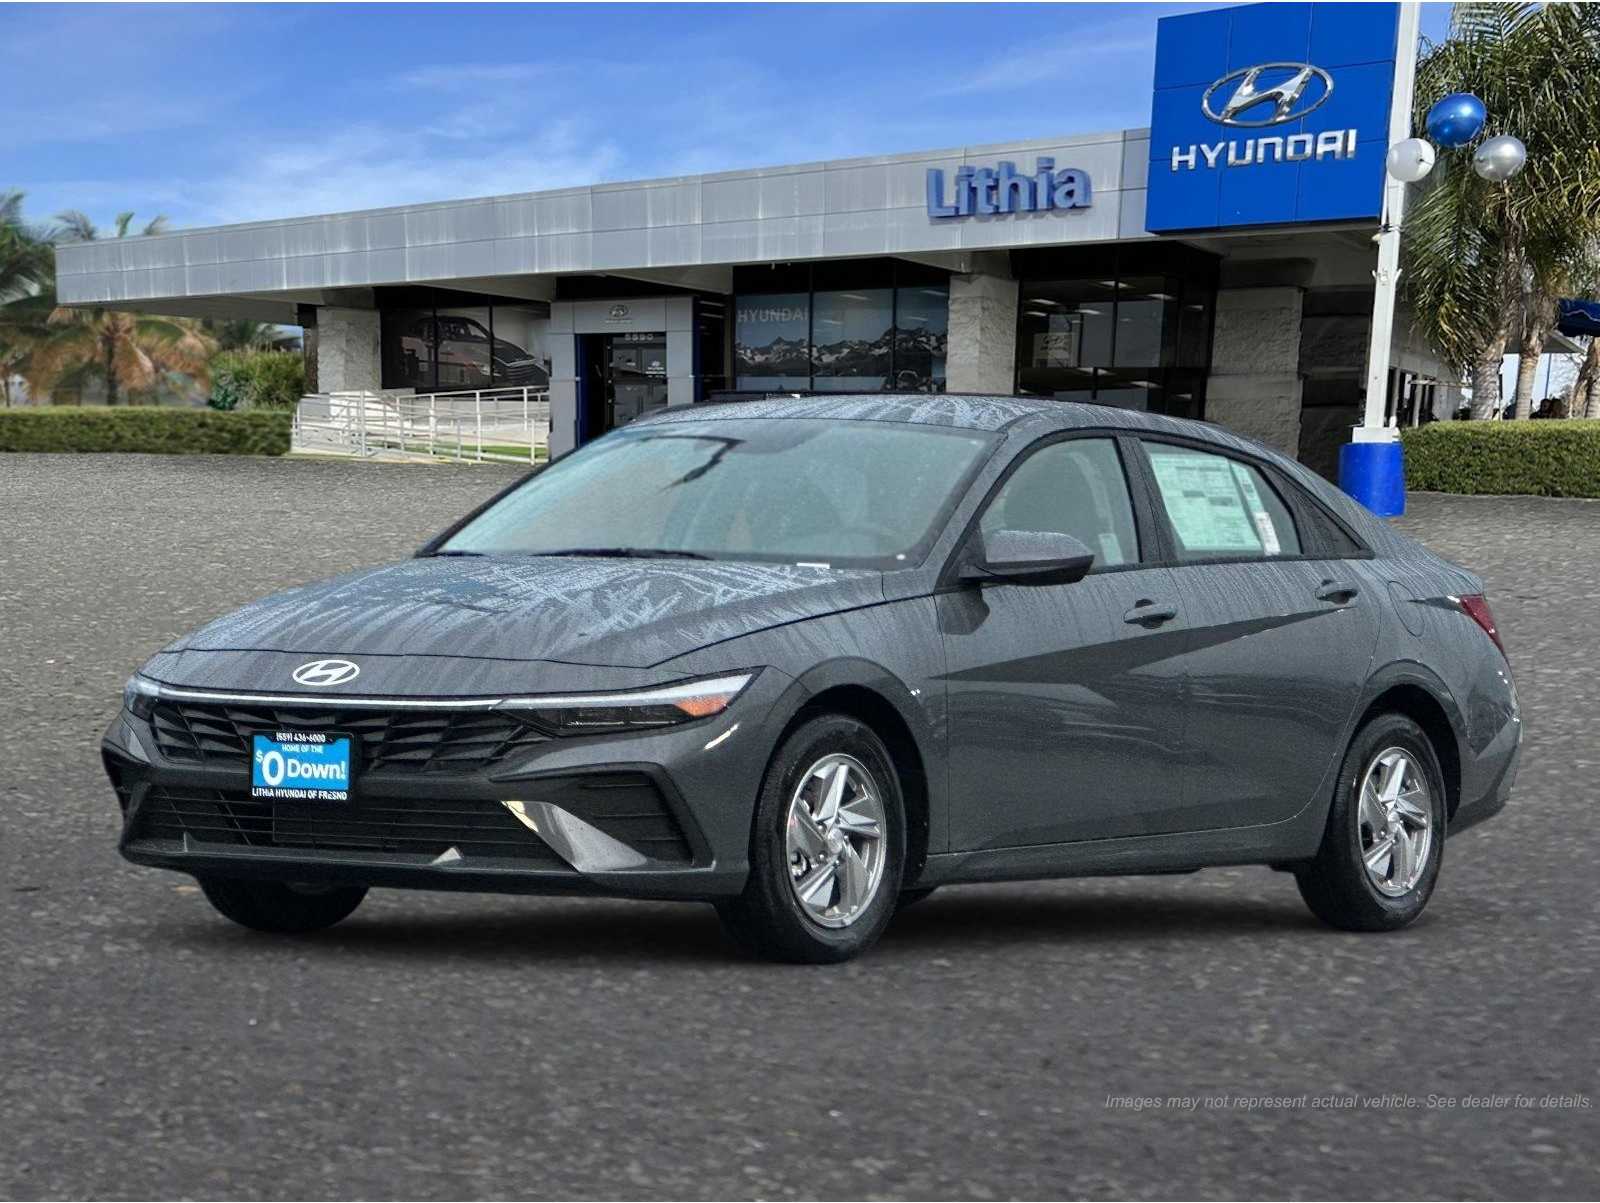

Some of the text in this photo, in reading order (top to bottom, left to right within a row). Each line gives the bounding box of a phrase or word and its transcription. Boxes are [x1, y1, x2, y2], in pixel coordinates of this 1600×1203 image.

[1171, 129, 1357, 172] HYUNDAI
[926, 156, 1092, 220] Lithia
[737, 307, 809, 323] HYUNDAI
[281, 744, 324, 753] HOME OF THE
[287, 758, 346, 780] Down!
[252, 788, 347, 801] LITHIA HYUNDAI OF FRESNO
